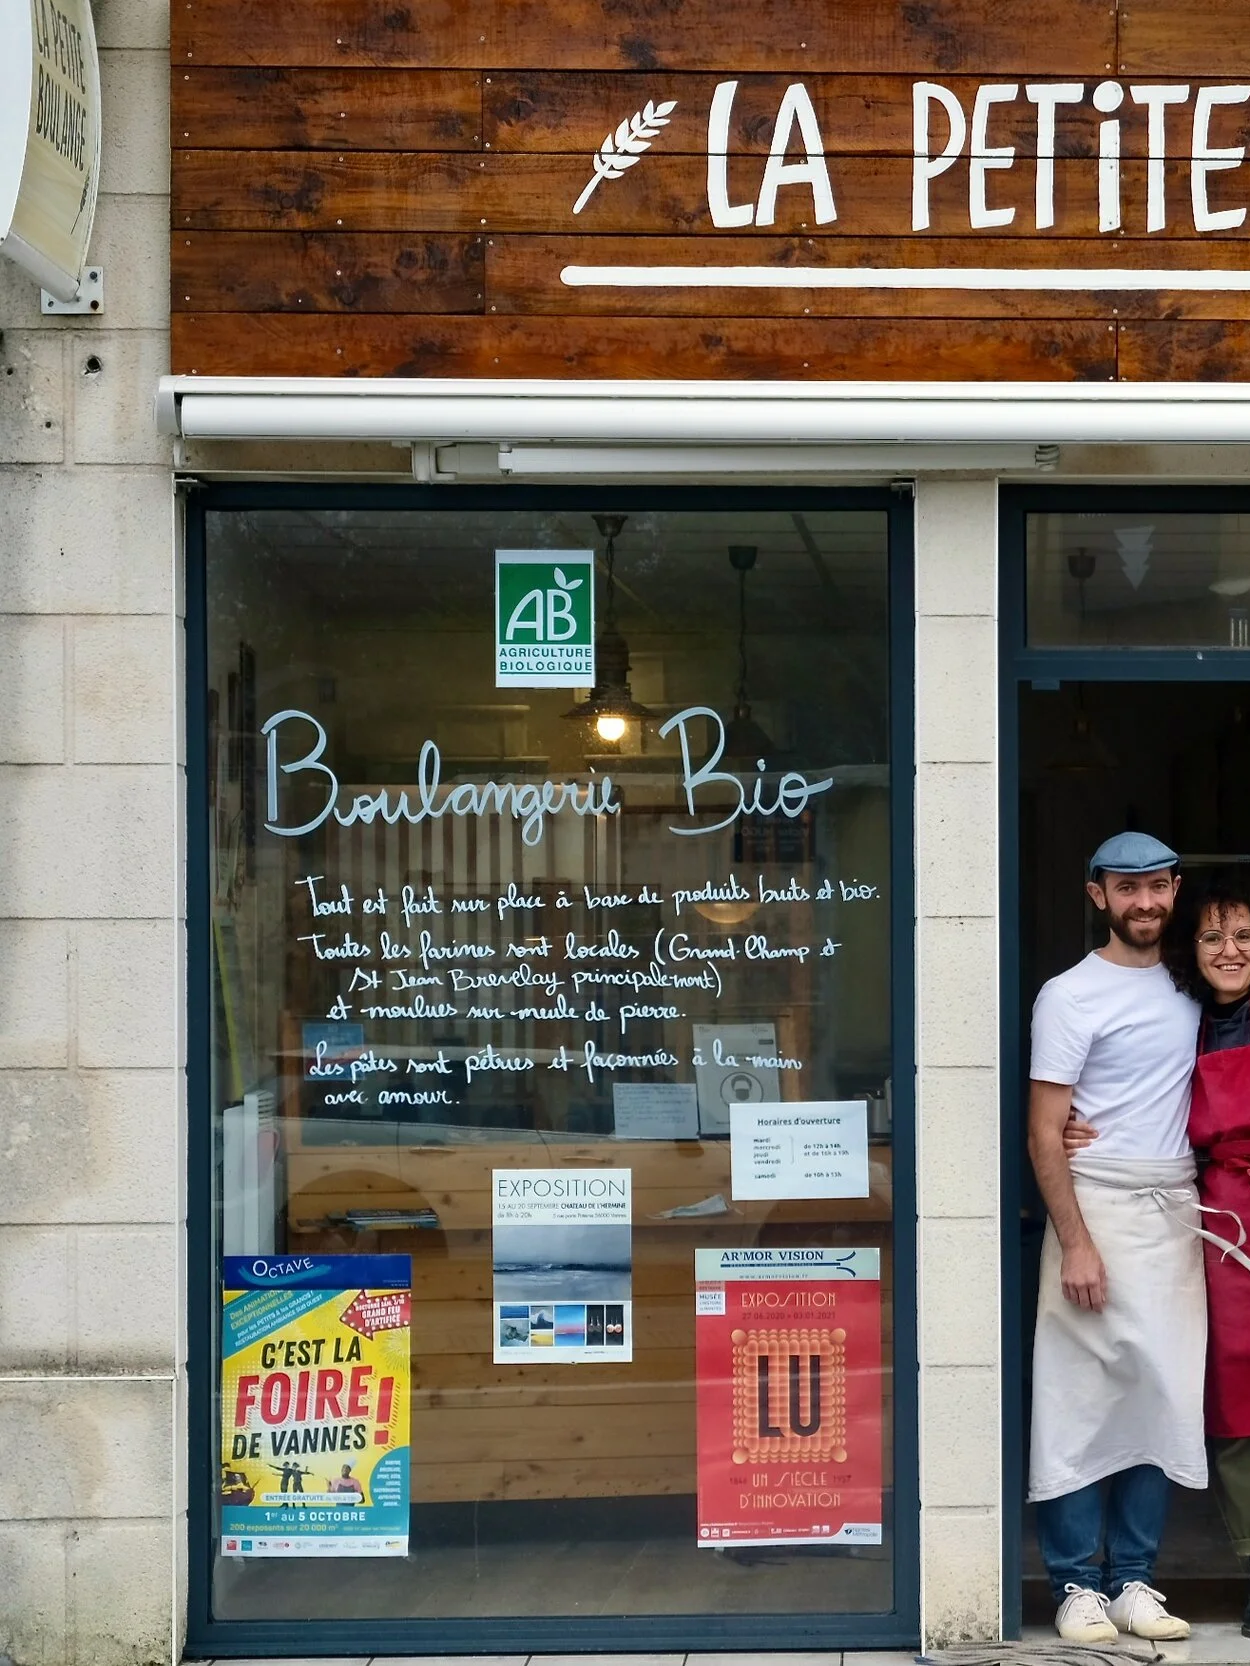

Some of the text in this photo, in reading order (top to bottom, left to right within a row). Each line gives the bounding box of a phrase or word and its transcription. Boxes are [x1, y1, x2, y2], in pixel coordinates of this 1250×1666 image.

[34, 0, 50, 59] LA
[36, 64, 87, 171] BOULANGE
[707, 80, 837, 228] LA
[504, 588, 578, 641] AB
[499, 648, 592, 657] AGRICULTURE
[500, 661, 592, 671] BIOLOGIQUE
[260, 706, 834, 846] Boulangerie Bio
[294, 876, 354, 917] Tout
[362, 888, 388, 915] est
[401, 885, 442, 928] fait
[451, 899, 490, 913] sur
[497, 883, 546, 920] place
[556, 891, 573, 909] à
[584, 886, 633, 910] base
[638, 886, 664, 905] de
[672, 874, 750, 916] produits
[816, 879, 834, 901] et
[839, 878, 881, 902] bio.
[297, 932, 371, 960] Toutes
[381, 931, 411, 960] les
[419, 930, 496, 970] farines
[506, 936, 553, 958] sont
[563, 929, 640, 960] locales
[819, 938, 842, 957] et
[348, 961, 722, 998] St Jean Brevelay principalement)
[326, 994, 687, 1035] et moulues sur meule de pierre.
[309, 1040, 345, 1077] Les
[350, 1050, 398, 1084] pâtes
[406, 1051, 452, 1074] sont
[547, 1046, 574, 1072] et
[692, 1048, 708, 1066] à
[712, 1038, 740, 1067] la
[324, 1088, 460, 1105] avec amour.
[757, 1117, 841, 1126] Horaires d'ouverture
[753, 1151, 769, 1159] jeudi
[498, 1178, 625, 1198] EXPOSITION
[527, 1202, 559, 1210] SEPTEMBRE
[720, 1250, 824, 1262] AR'MOR VISION
[741, 1292, 836, 1307] EXPOSITION
[362, 1305, 400, 1319] GRAND FEU
[364, 1314, 400, 1327] D'ARTIFICE
[261, 1336, 362, 1369] C'EST LA
[758, 1355, 821, 1438] LU
[231, 1423, 367, 1461] DE VANNES
[752, 1473, 768, 1487] UN
[291, 1494, 324, 1502] GRATUITE
[739, 1492, 842, 1510] D'INNOVATION
[281, 1513, 294, 1522] au
[298, 1512, 305, 1522] 5
[309, 1511, 366, 1522] OCTOBRE
